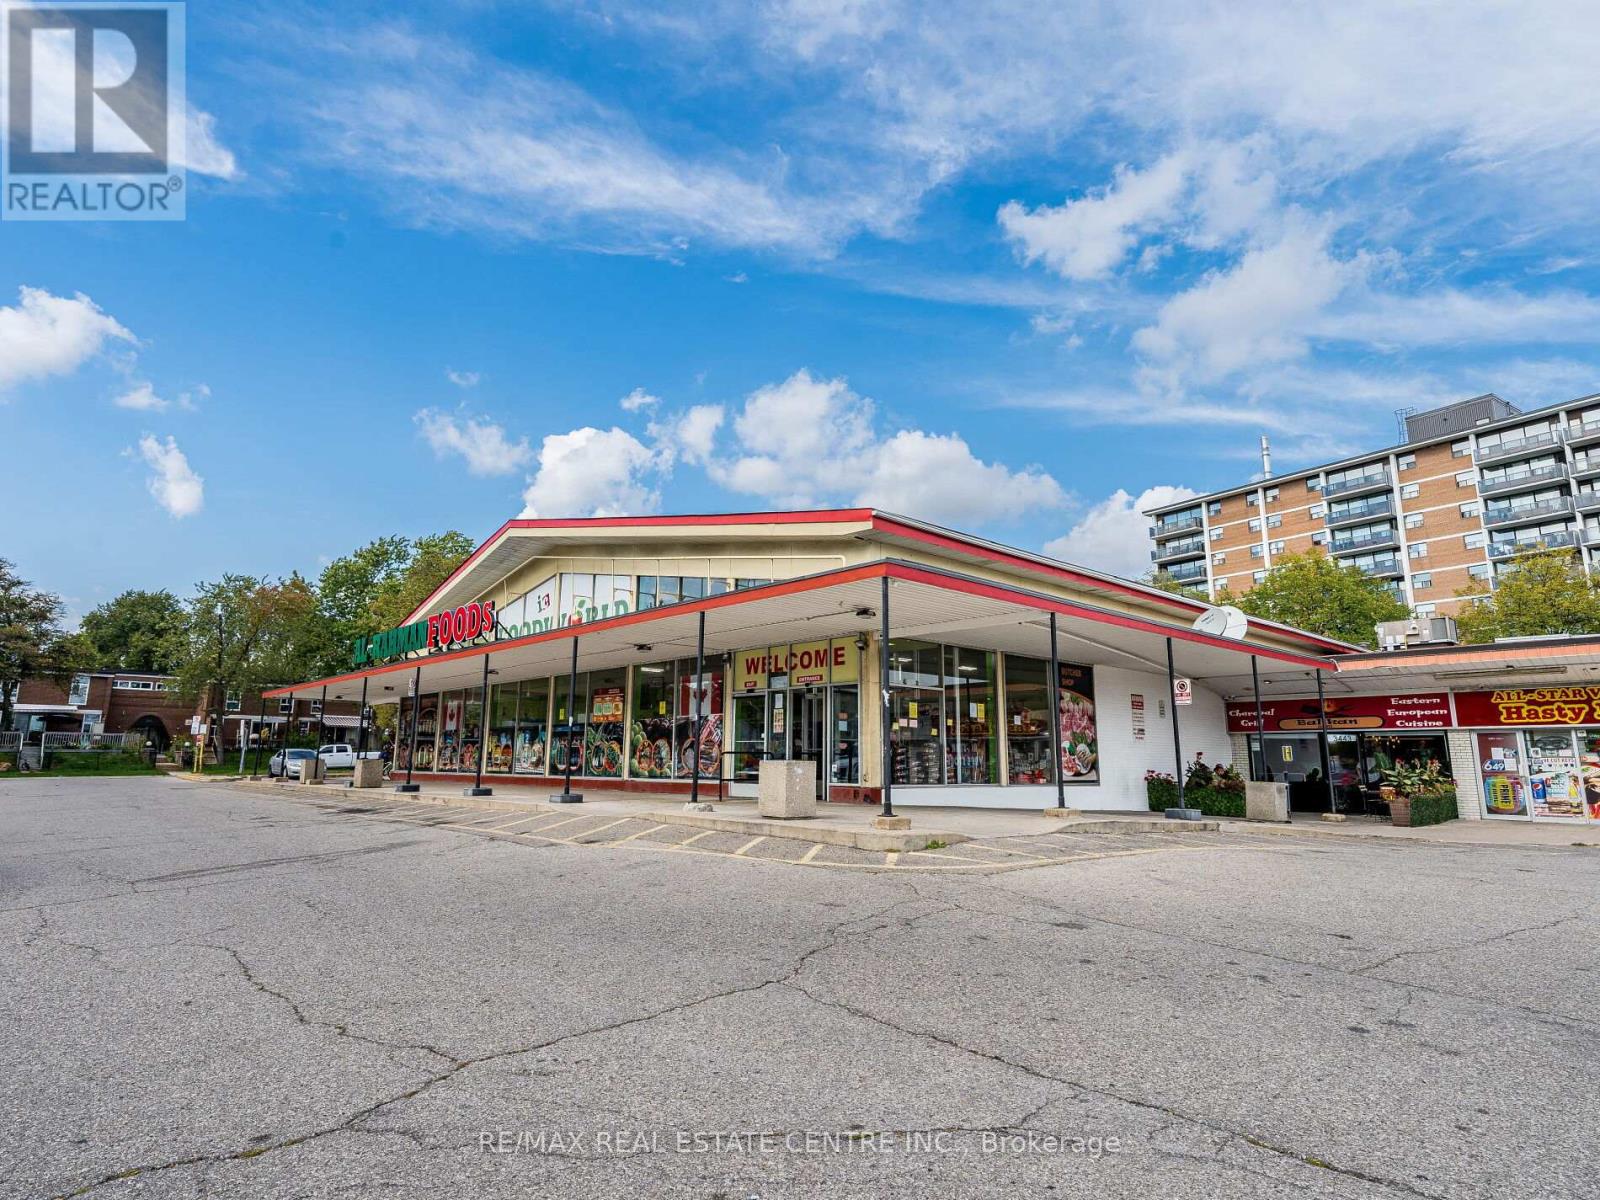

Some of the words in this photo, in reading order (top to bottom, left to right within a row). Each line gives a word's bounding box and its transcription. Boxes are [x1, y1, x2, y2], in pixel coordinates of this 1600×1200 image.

[427, 602, 491, 648] FOODS
[745, 647, 845, 674] WELCOME
[1391, 697, 1441, 705] Eastern
[1491, 688, 1587, 703] ALL-STAR
[1387, 709, 1448, 718] European
[1499, 702, 1589, 724] Hasty
